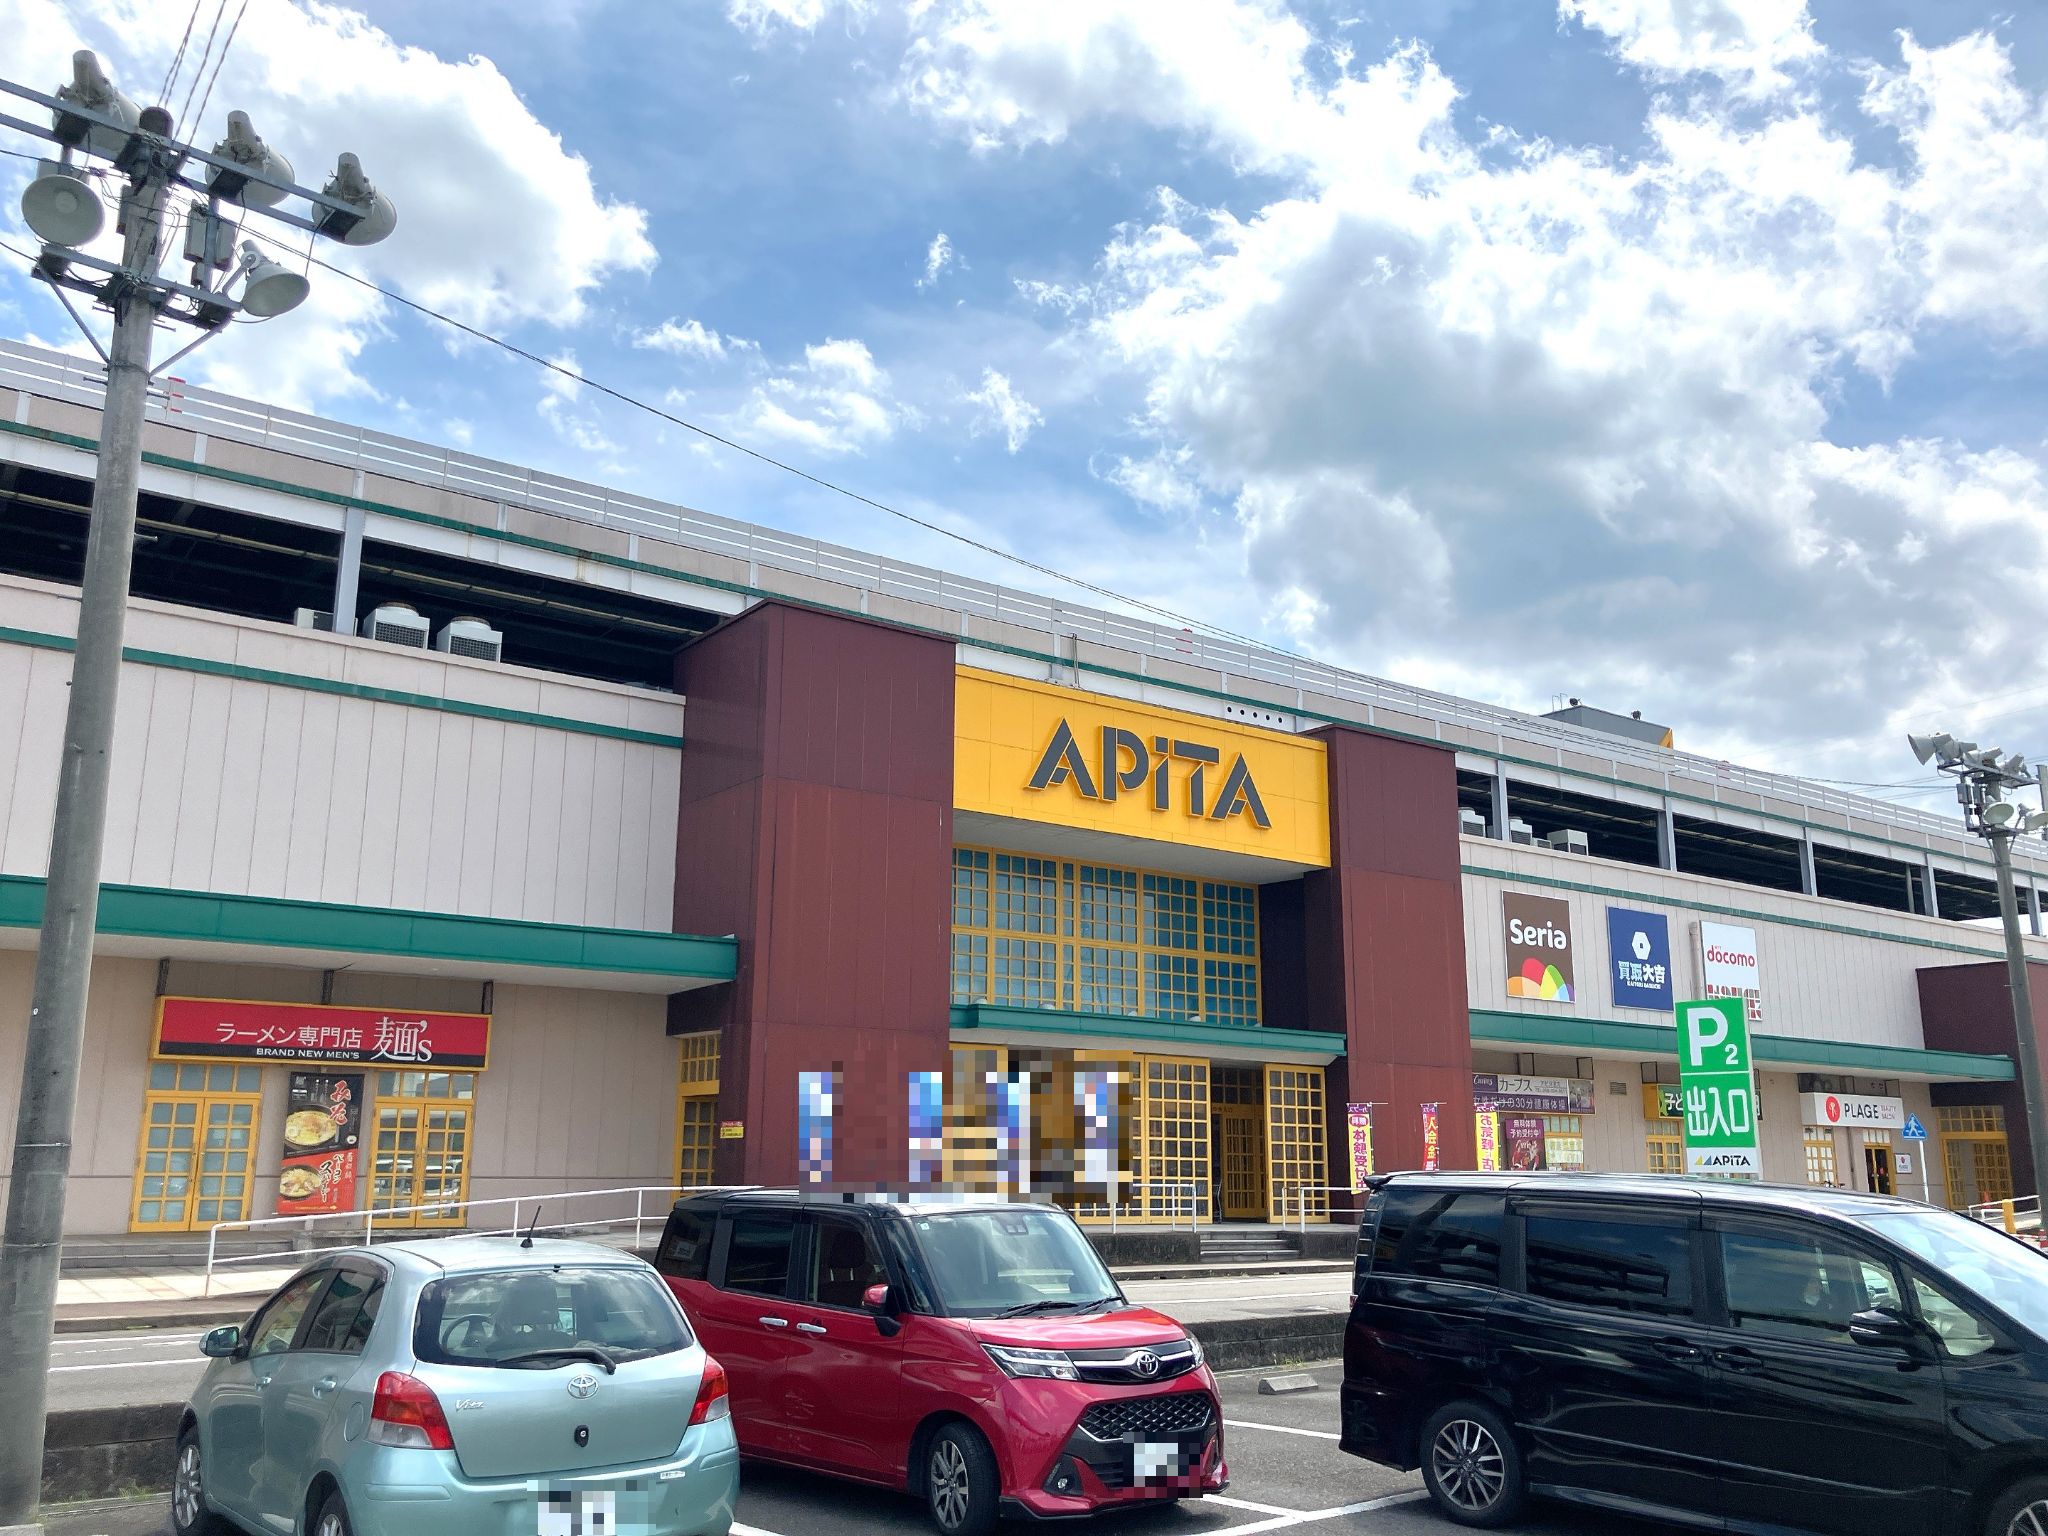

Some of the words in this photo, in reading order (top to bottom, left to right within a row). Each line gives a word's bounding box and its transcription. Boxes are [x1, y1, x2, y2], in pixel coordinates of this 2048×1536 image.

[1508, 918, 1567, 950] Seria
[1706, 945, 1756, 968] docomo
[1617, 960, 1666, 984] 買取大吉
[215, 1022, 364, 1049] ラーメン専門店
[256, 1047, 296, 1057] BRAND
[298, 1049, 323, 1058] NEW
[326, 1050, 360, 1060] MEN'S
[1686, 1086, 1750, 1137] 出入口
[1844, 1103, 1880, 1120] PLAGE
